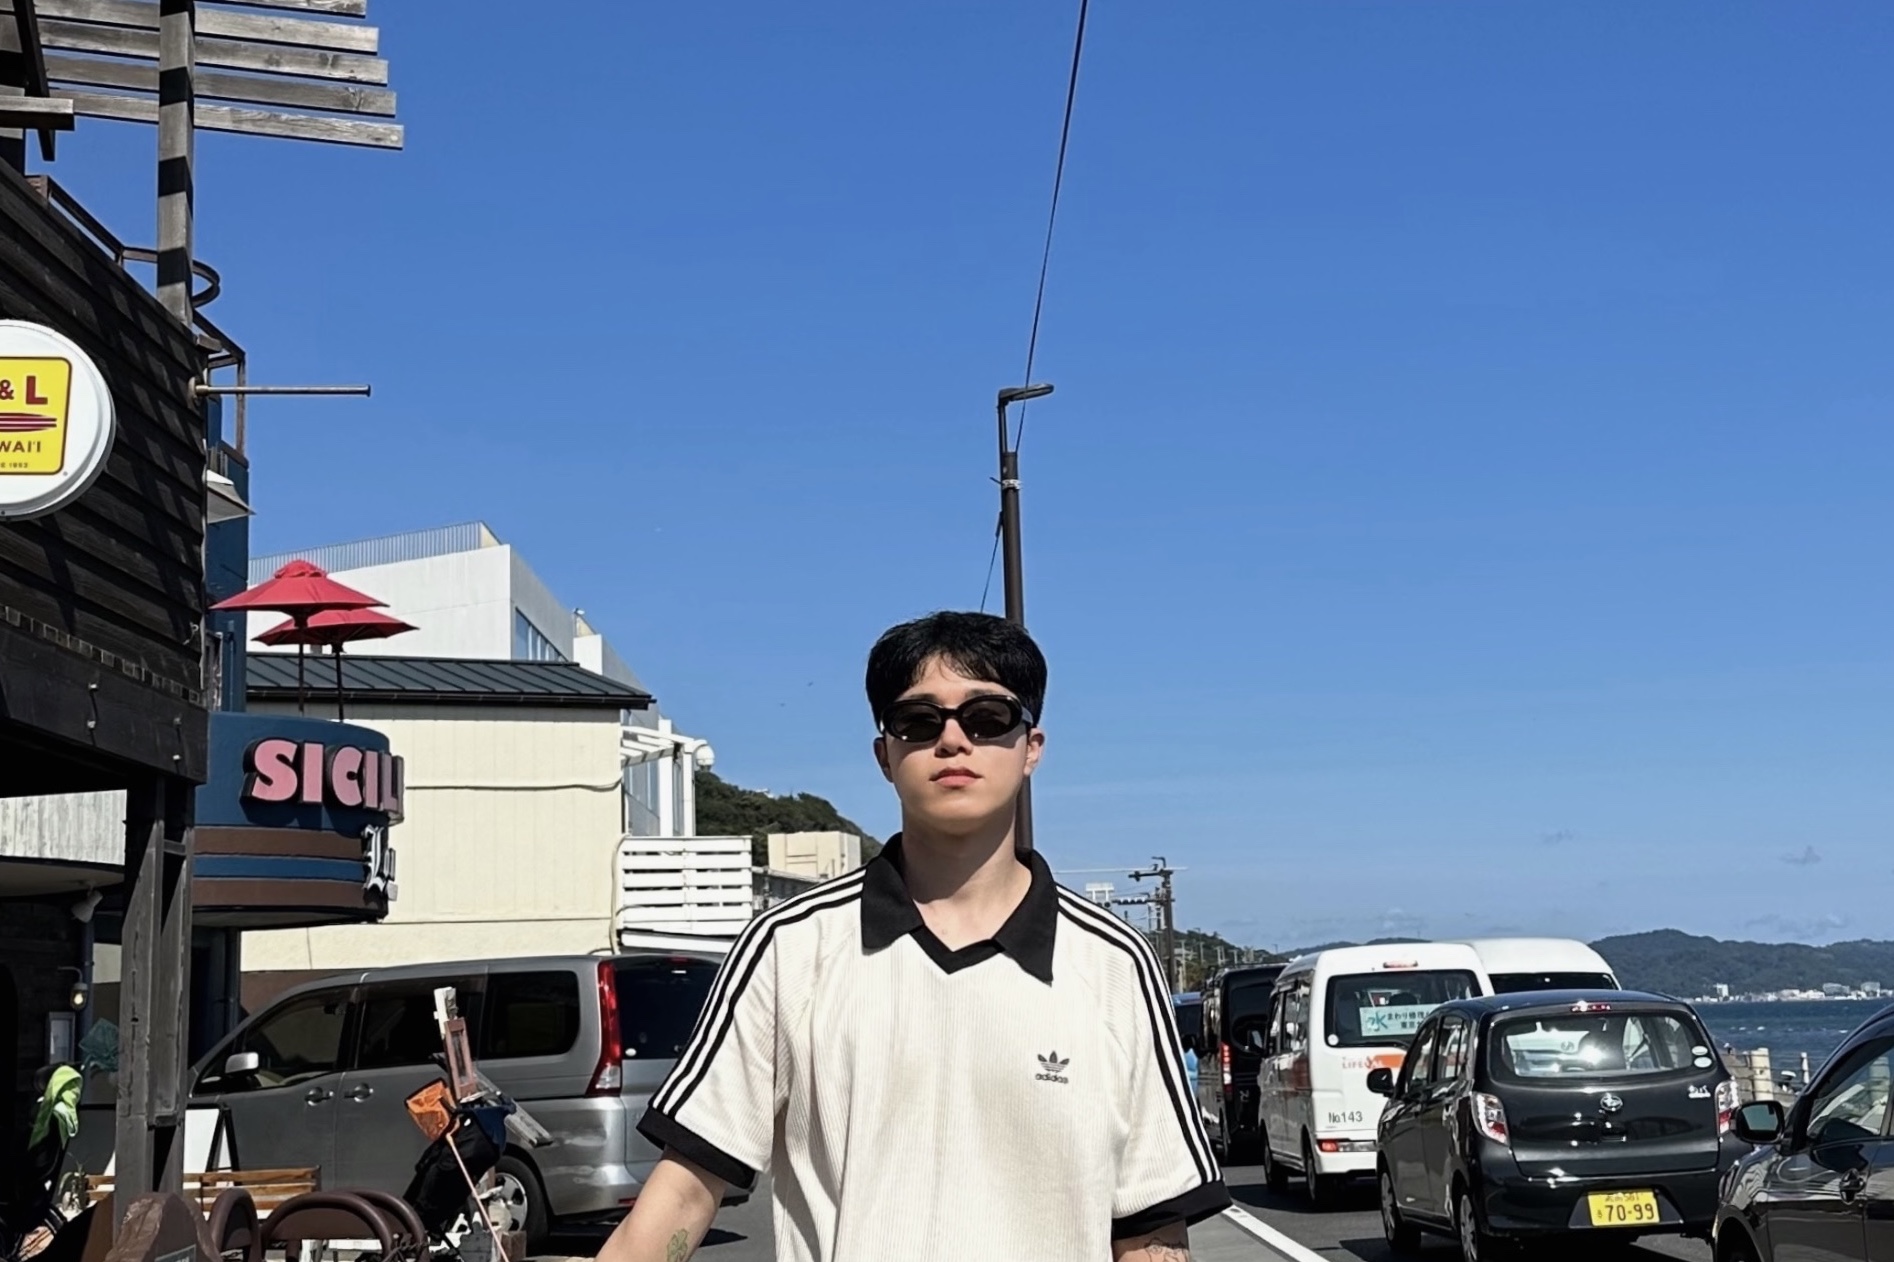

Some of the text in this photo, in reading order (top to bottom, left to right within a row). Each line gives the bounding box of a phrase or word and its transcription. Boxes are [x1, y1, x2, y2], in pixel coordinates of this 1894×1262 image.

[25, 375, 49, 405] L
[1035, 1073, 1069, 1084] adidas
[1604, 1203, 1655, 1222] 70-99
